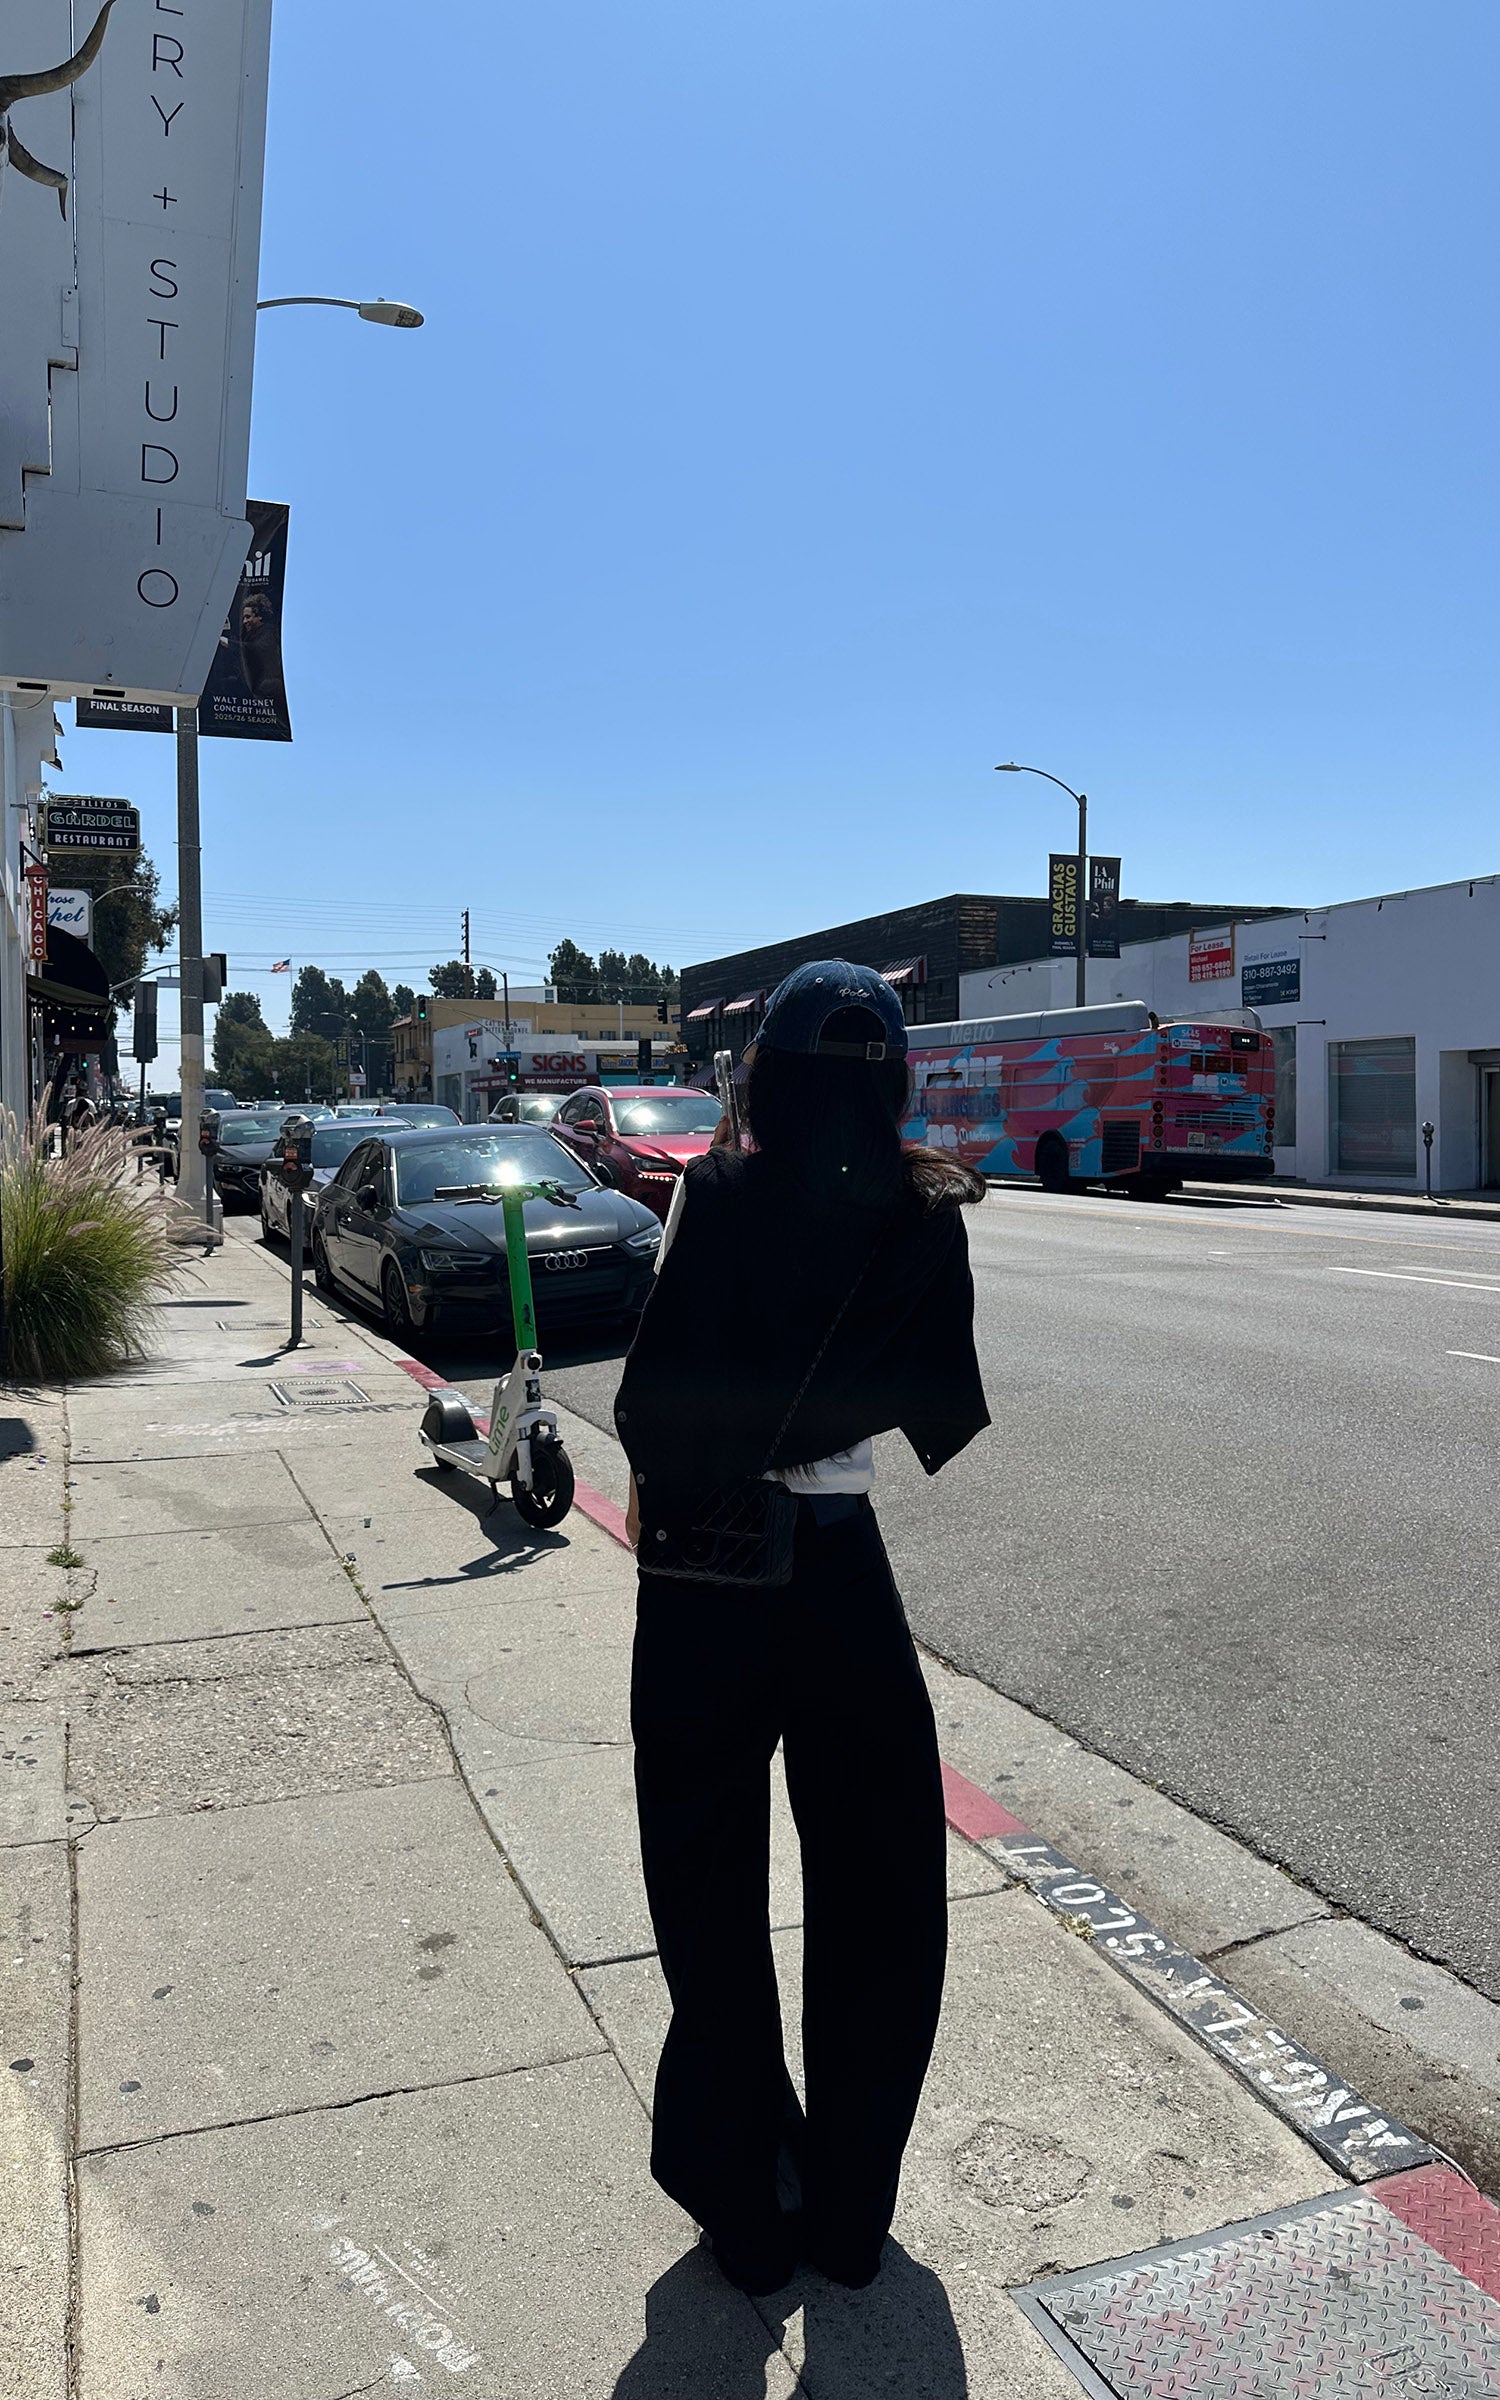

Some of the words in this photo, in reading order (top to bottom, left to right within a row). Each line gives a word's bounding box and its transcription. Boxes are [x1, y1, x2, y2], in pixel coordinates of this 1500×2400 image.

[137, 259, 179, 608] STUDIO
[90, 700, 119, 711] FINAL
[121, 704, 160, 715] SEASON
[213, 696, 236, 705] WALT
[242, 698, 274, 707] DISNEY
[213, 704, 253, 714] CONCERT
[255, 707, 277, 716] HALL
[214, 713, 246, 722] 2025/26
[247, 715, 277, 724] SEASON
[49, 812, 135, 828] GARDEL
[55, 834, 130, 846] RESTAURANT
[1095, 866, 1108, 878] LA
[1094, 878, 1115, 890] Phil
[1052, 863, 1065, 936] GRACIAS
[1064, 864, 1077, 936] GUSTAVO
[33, 876, 44, 956] CHICAGO
[1190, 944, 1202, 952] For
[1203, 941, 1224, 950] Lease
[1243, 963, 1297, 980] 310-887-3492
[950, 1023, 995, 1044] Metro
[532, 1055, 587, 1072] SIGNS
[489, 1406, 509, 1456] Lime
